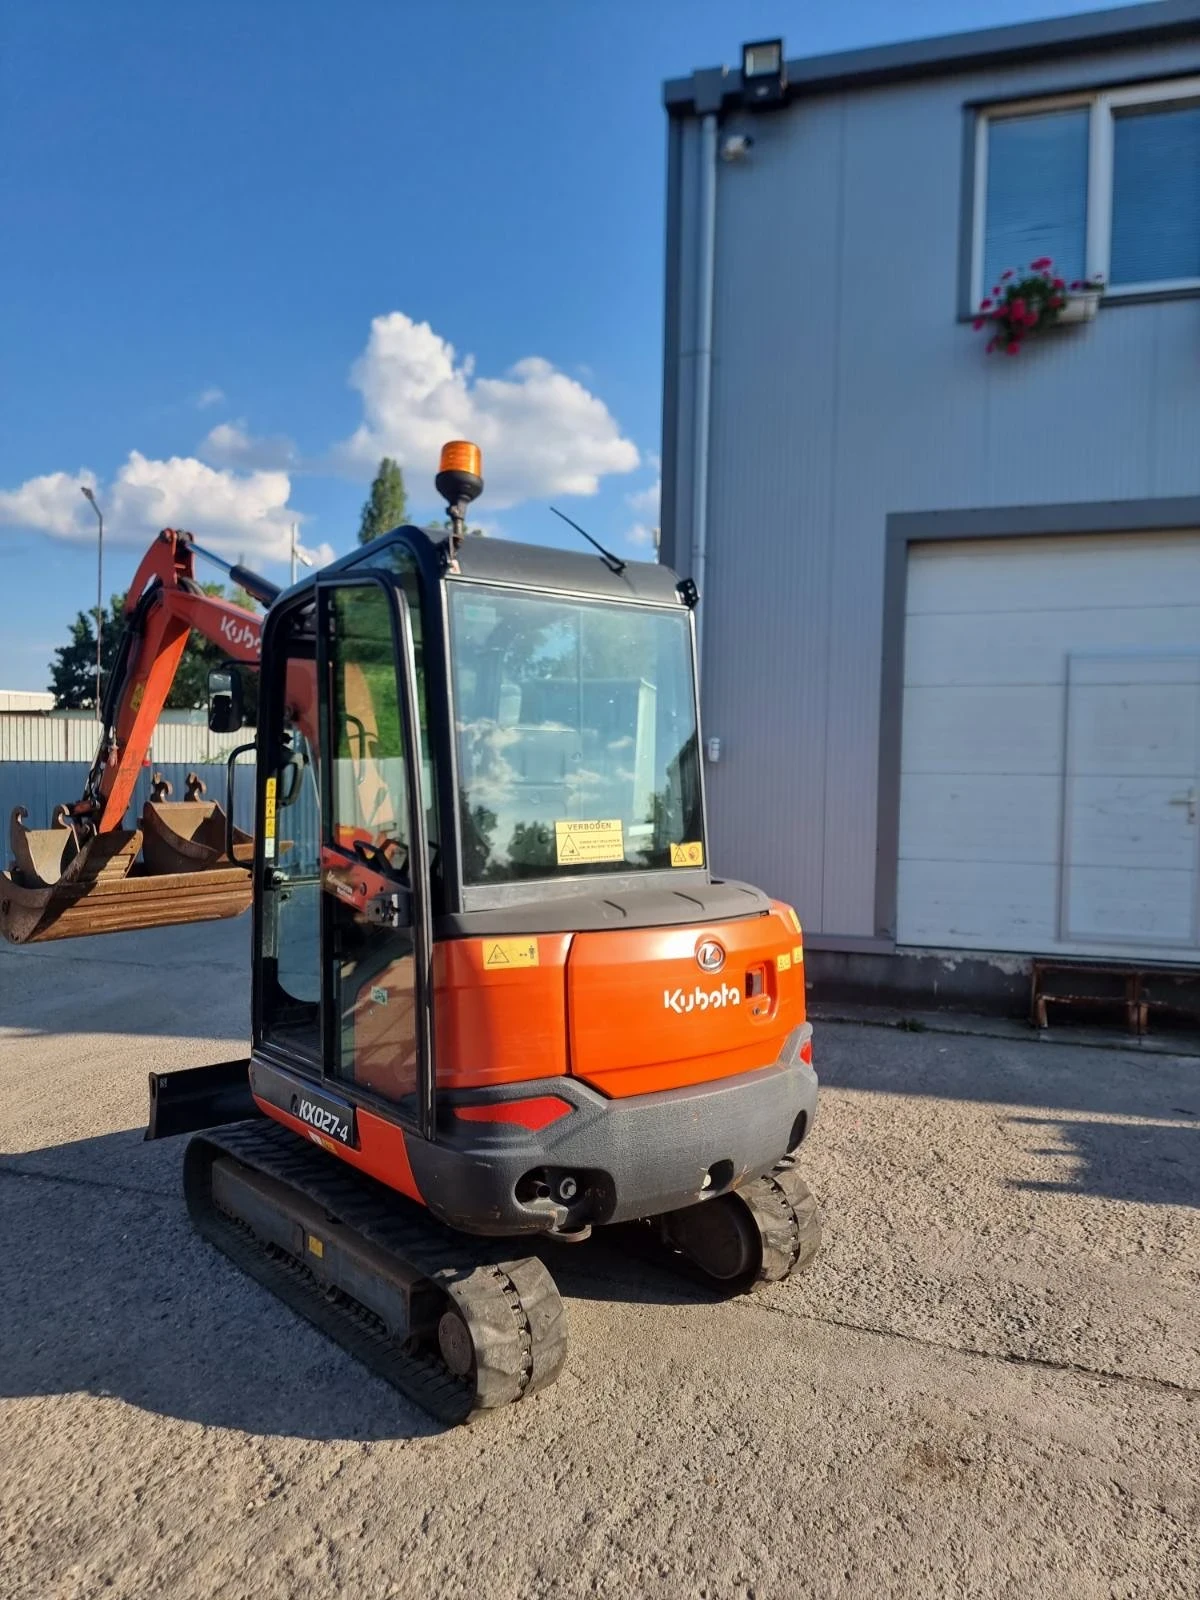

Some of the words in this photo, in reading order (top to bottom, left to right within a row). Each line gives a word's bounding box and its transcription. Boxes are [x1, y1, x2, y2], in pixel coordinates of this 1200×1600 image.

[566, 822, 612, 831] VERBODEN
[663, 982, 741, 1014] Kubota
[299, 1099, 349, 1142] KX027-4
